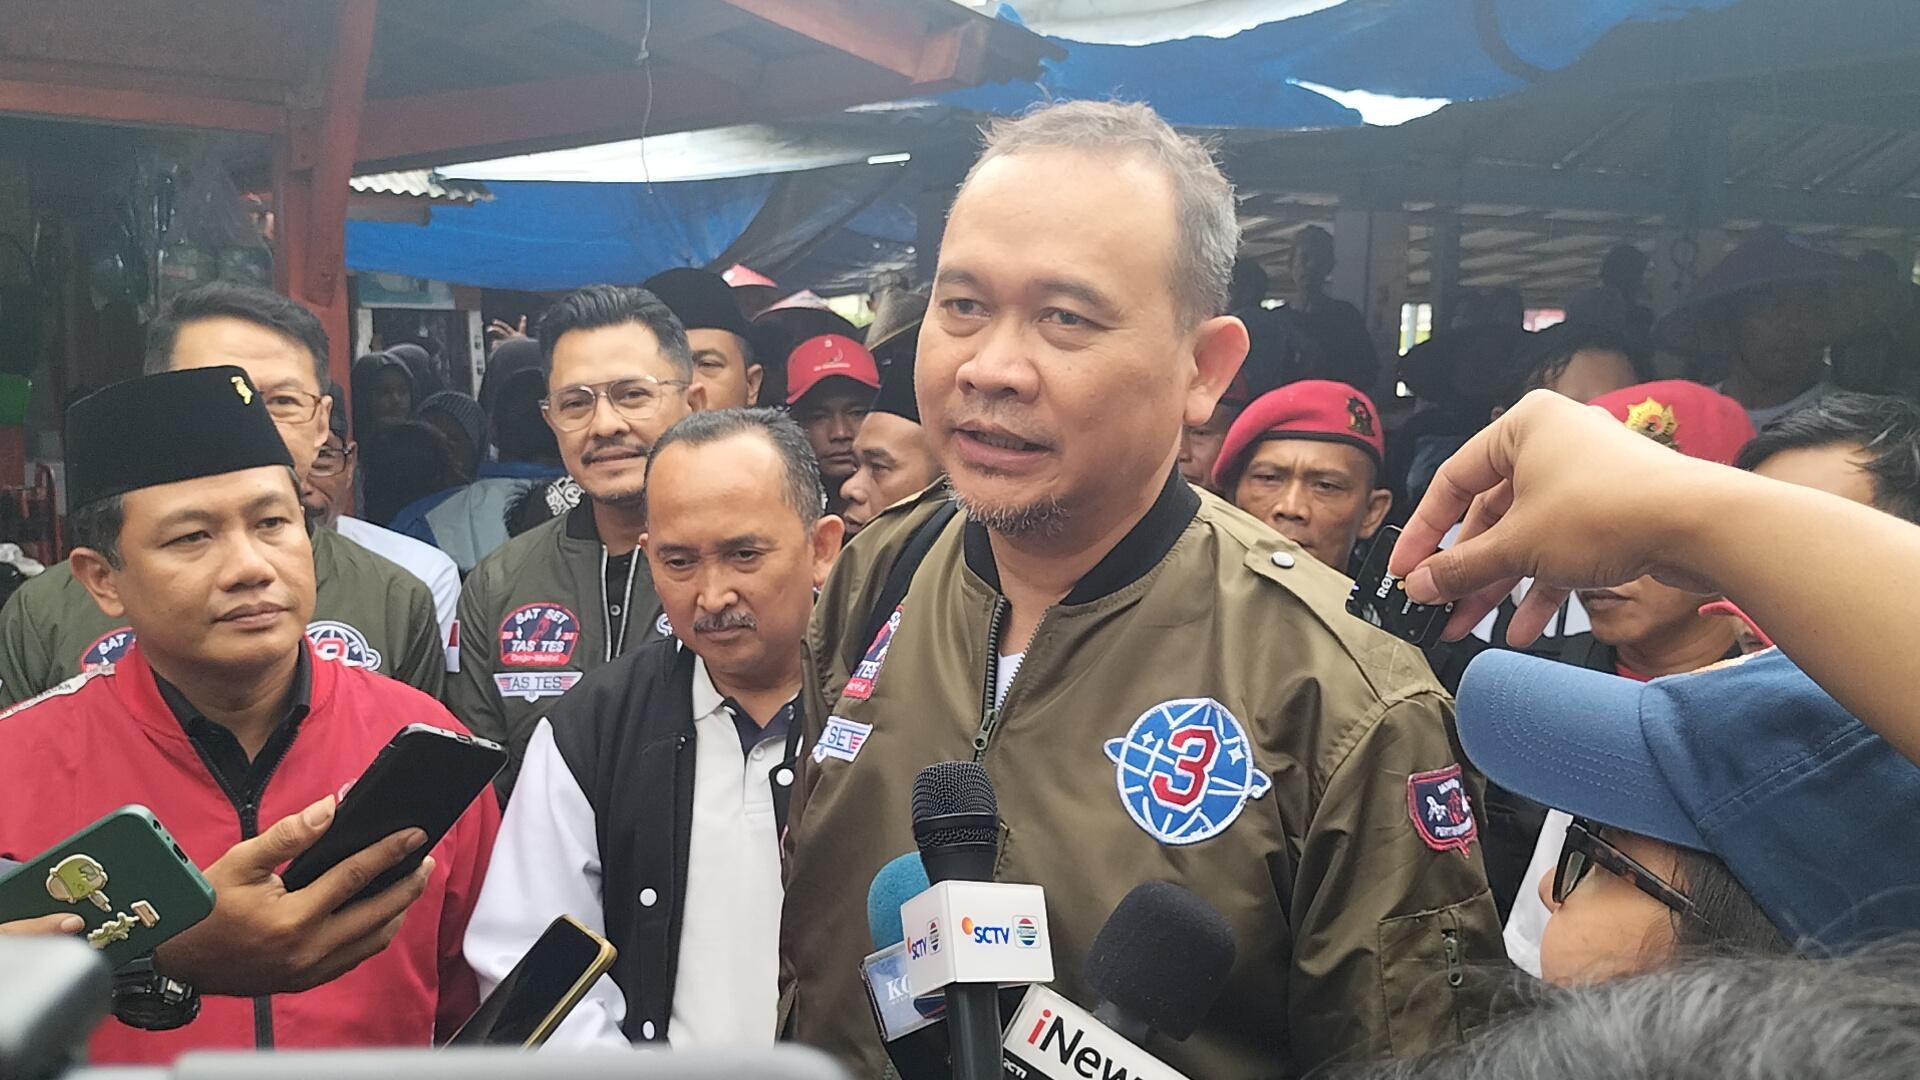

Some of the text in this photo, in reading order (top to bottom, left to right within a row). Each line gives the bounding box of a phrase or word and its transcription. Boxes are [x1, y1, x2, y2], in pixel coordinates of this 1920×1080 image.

[515, 608, 570, 624] SAT SET
[98, 633, 126, 655] SAT
[511, 640, 566, 653] TAS TES
[536, 676, 562, 689] TES
[1150, 725, 1220, 812] 3
[974, 926, 1010, 944] SCTV
[911, 937, 927, 960] SCTV
